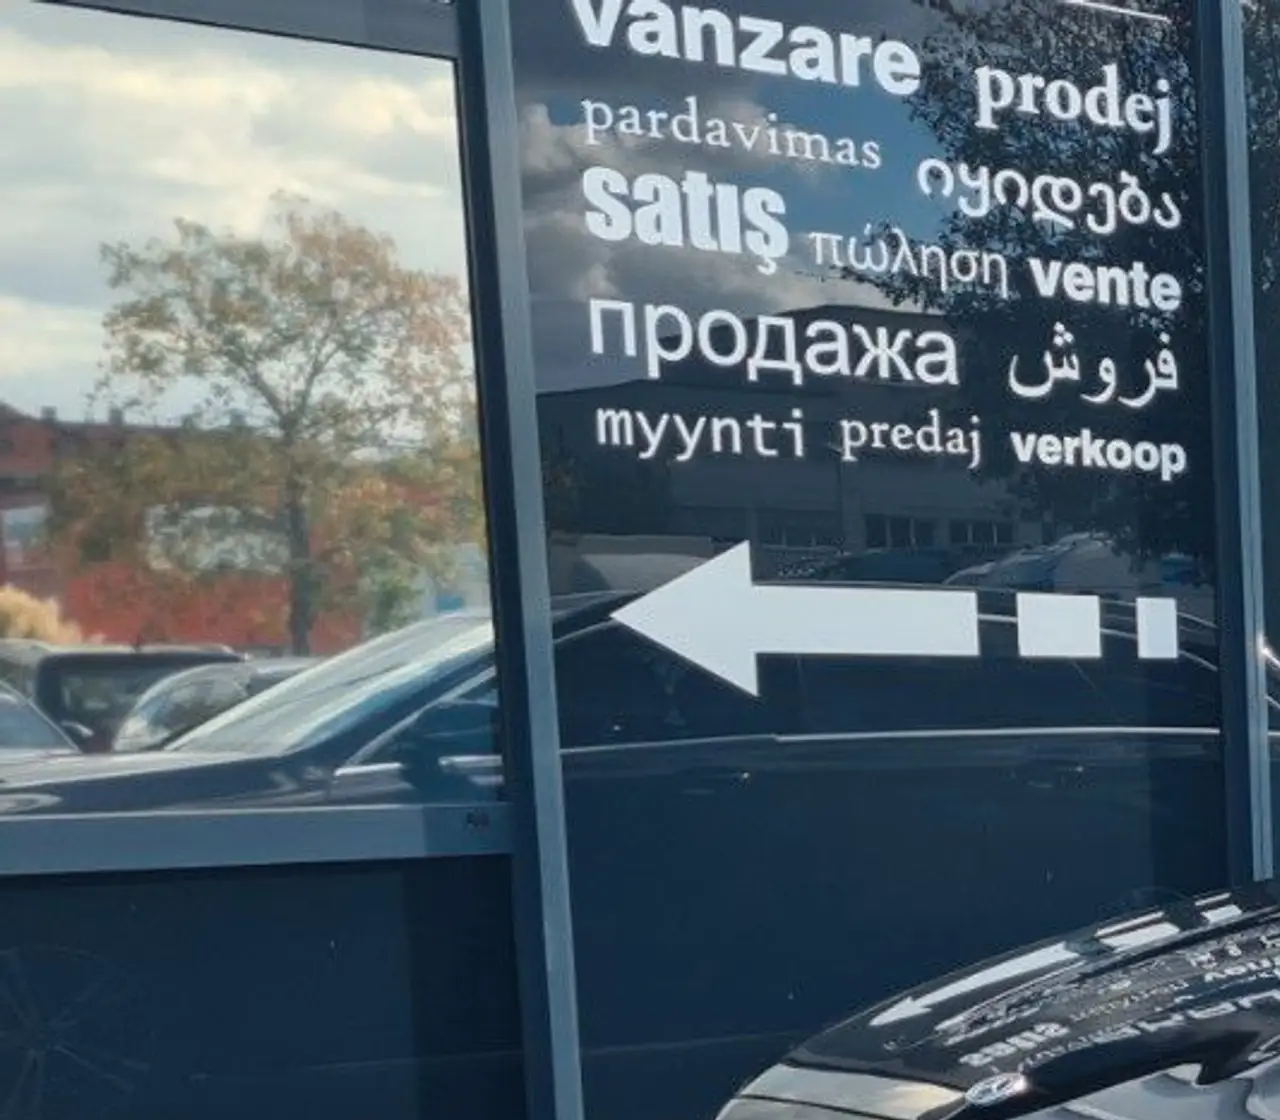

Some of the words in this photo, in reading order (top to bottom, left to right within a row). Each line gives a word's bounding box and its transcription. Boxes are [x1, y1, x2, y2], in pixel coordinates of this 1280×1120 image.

[582, 99, 881, 168] pardavimas
[975, 64, 1171, 154] prodej
[583, 167, 789, 275] satış
[917, 158, 1180, 234] იყიდება
[810, 223, 1009, 299] πώληση
[1028, 258, 1181, 310] vente
[589, 299, 959, 385] продажа
[597, 408, 804, 461] myynti
[841, 409, 981, 468] predaj
[1010, 429, 1186, 481] verkoop
